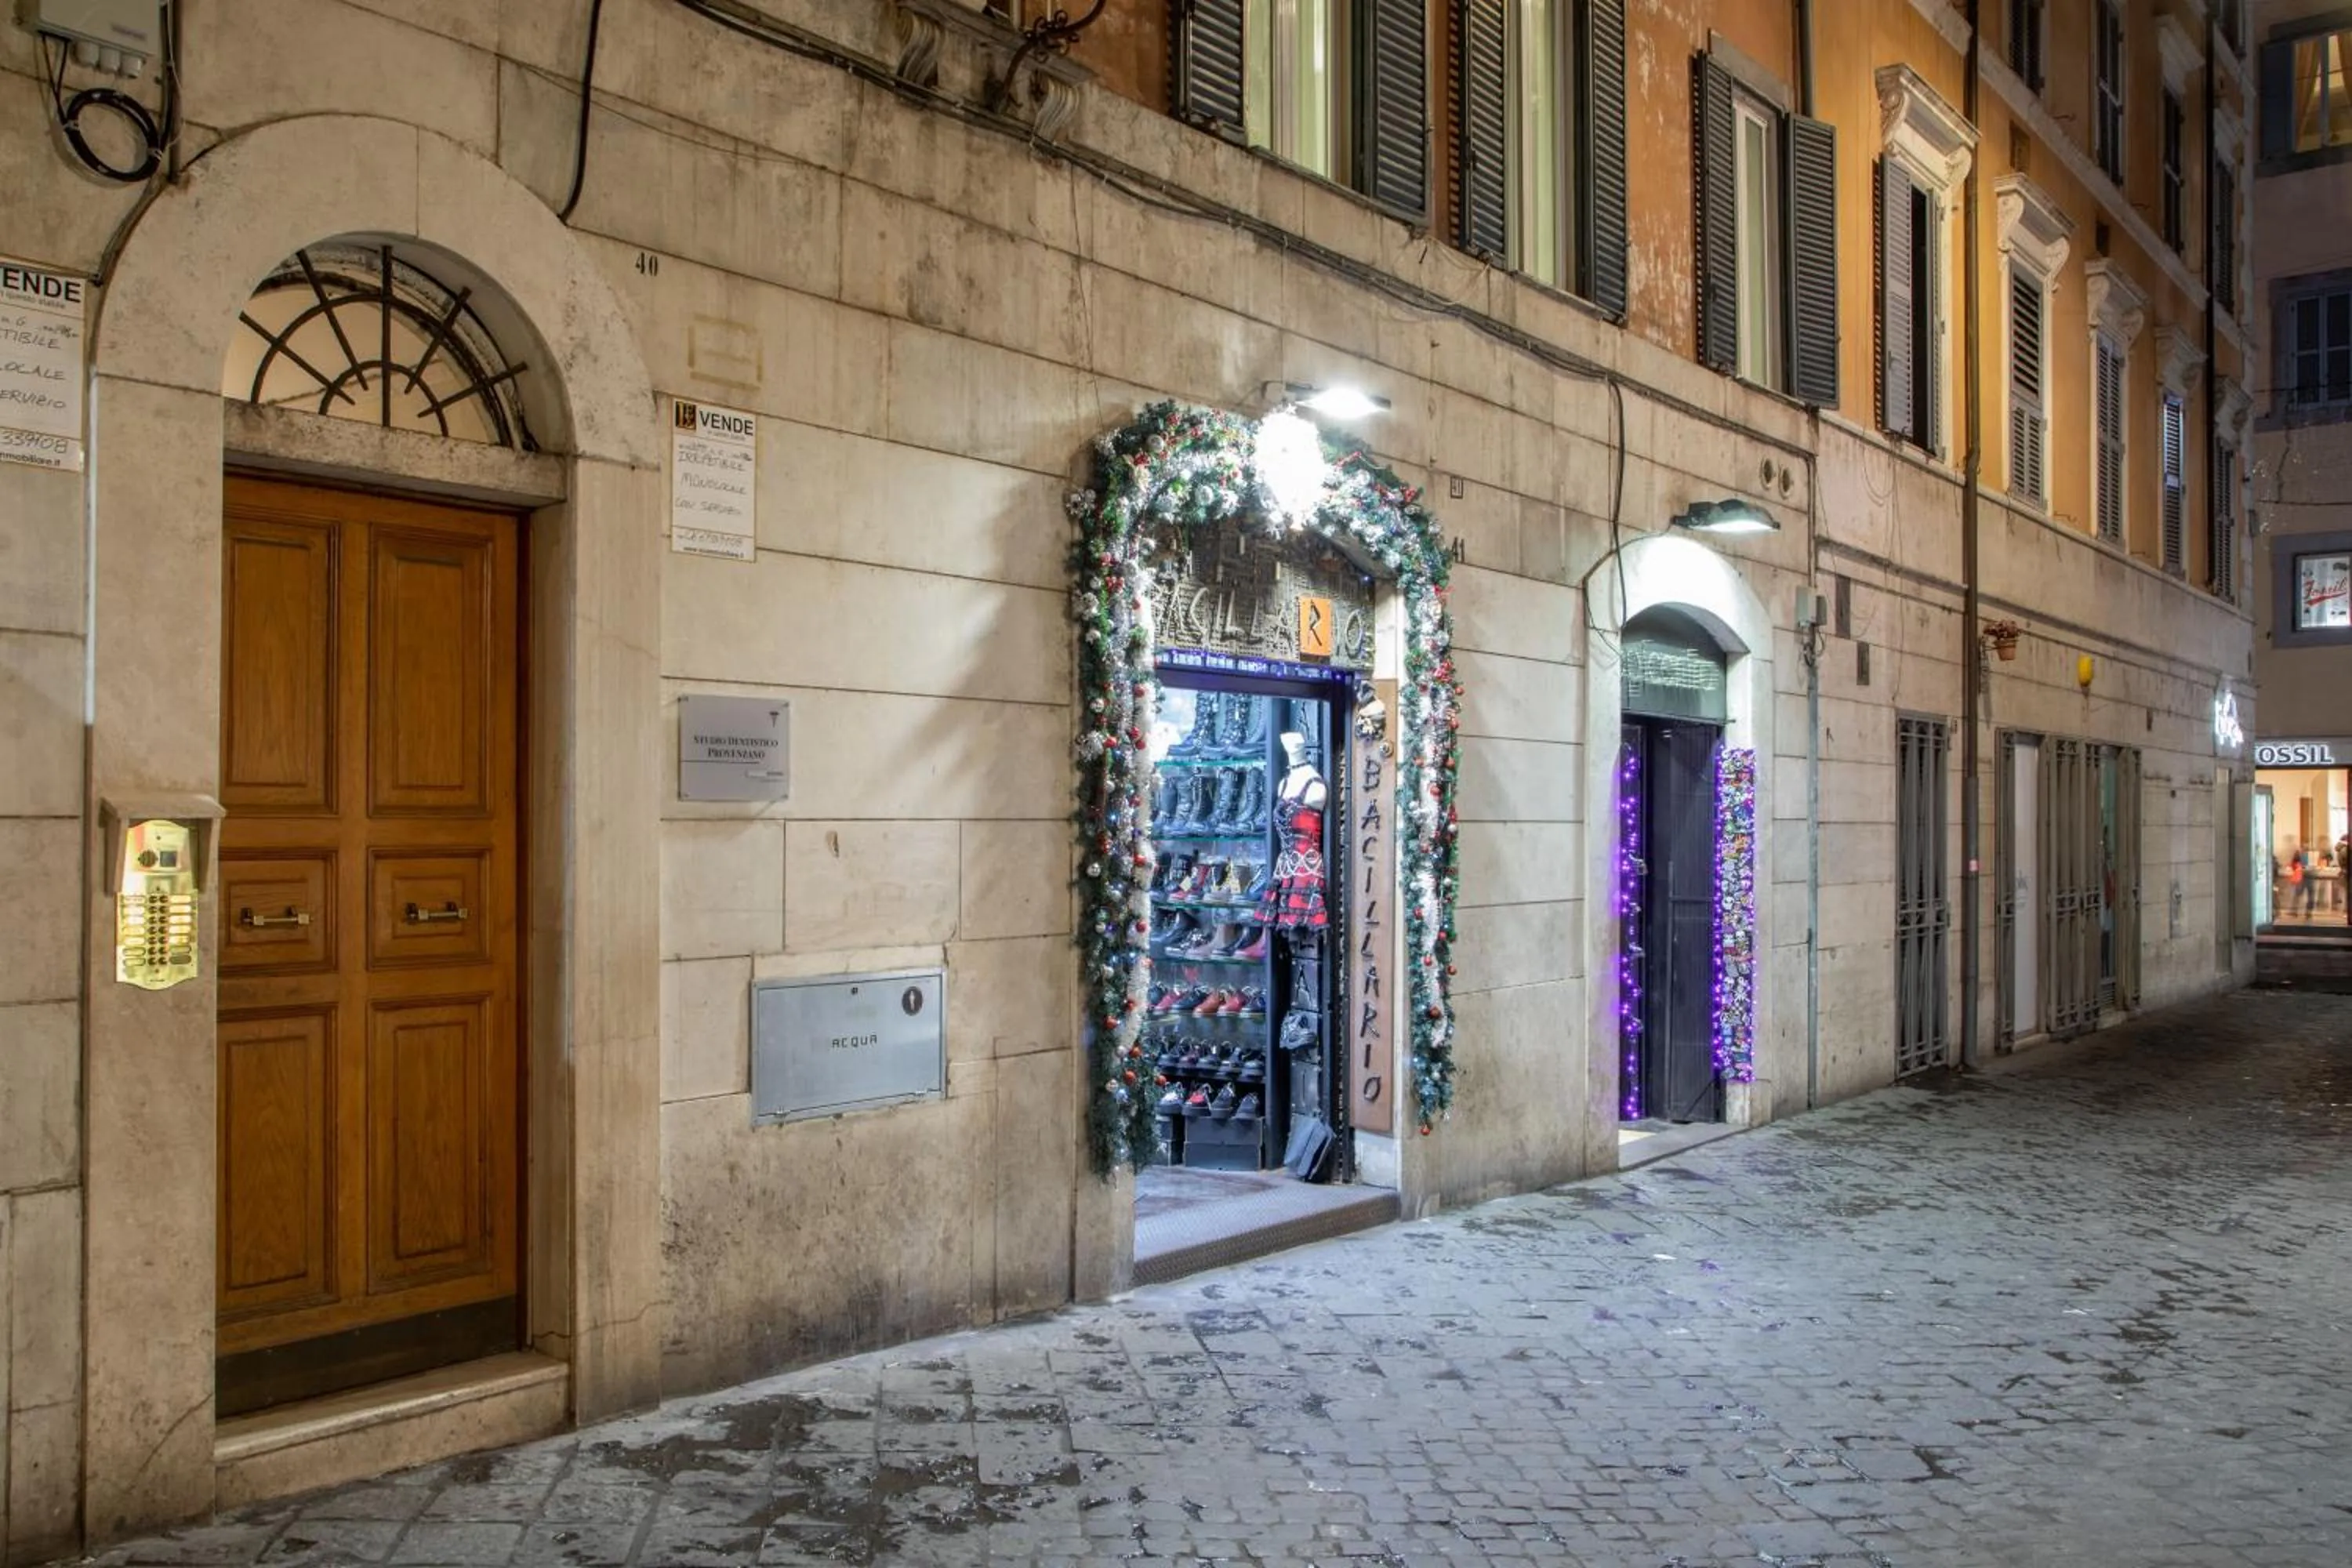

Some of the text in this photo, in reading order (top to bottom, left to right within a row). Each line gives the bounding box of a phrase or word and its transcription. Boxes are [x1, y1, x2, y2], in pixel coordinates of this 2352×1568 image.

[635, 252, 658, 277] 40
[0, 267, 81, 303] ENDE
[0, 361, 66, 380] OCALE
[0, 389, 66, 408] ERVIZIO
[699, 410, 753, 437] VENDE
[1451, 536, 1465, 563] 41
[2255, 746, 2333, 764] OSSIL
[1361, 757, 1381, 1102] BACILLARIO
[832, 1034, 878, 1048] ACQUA
